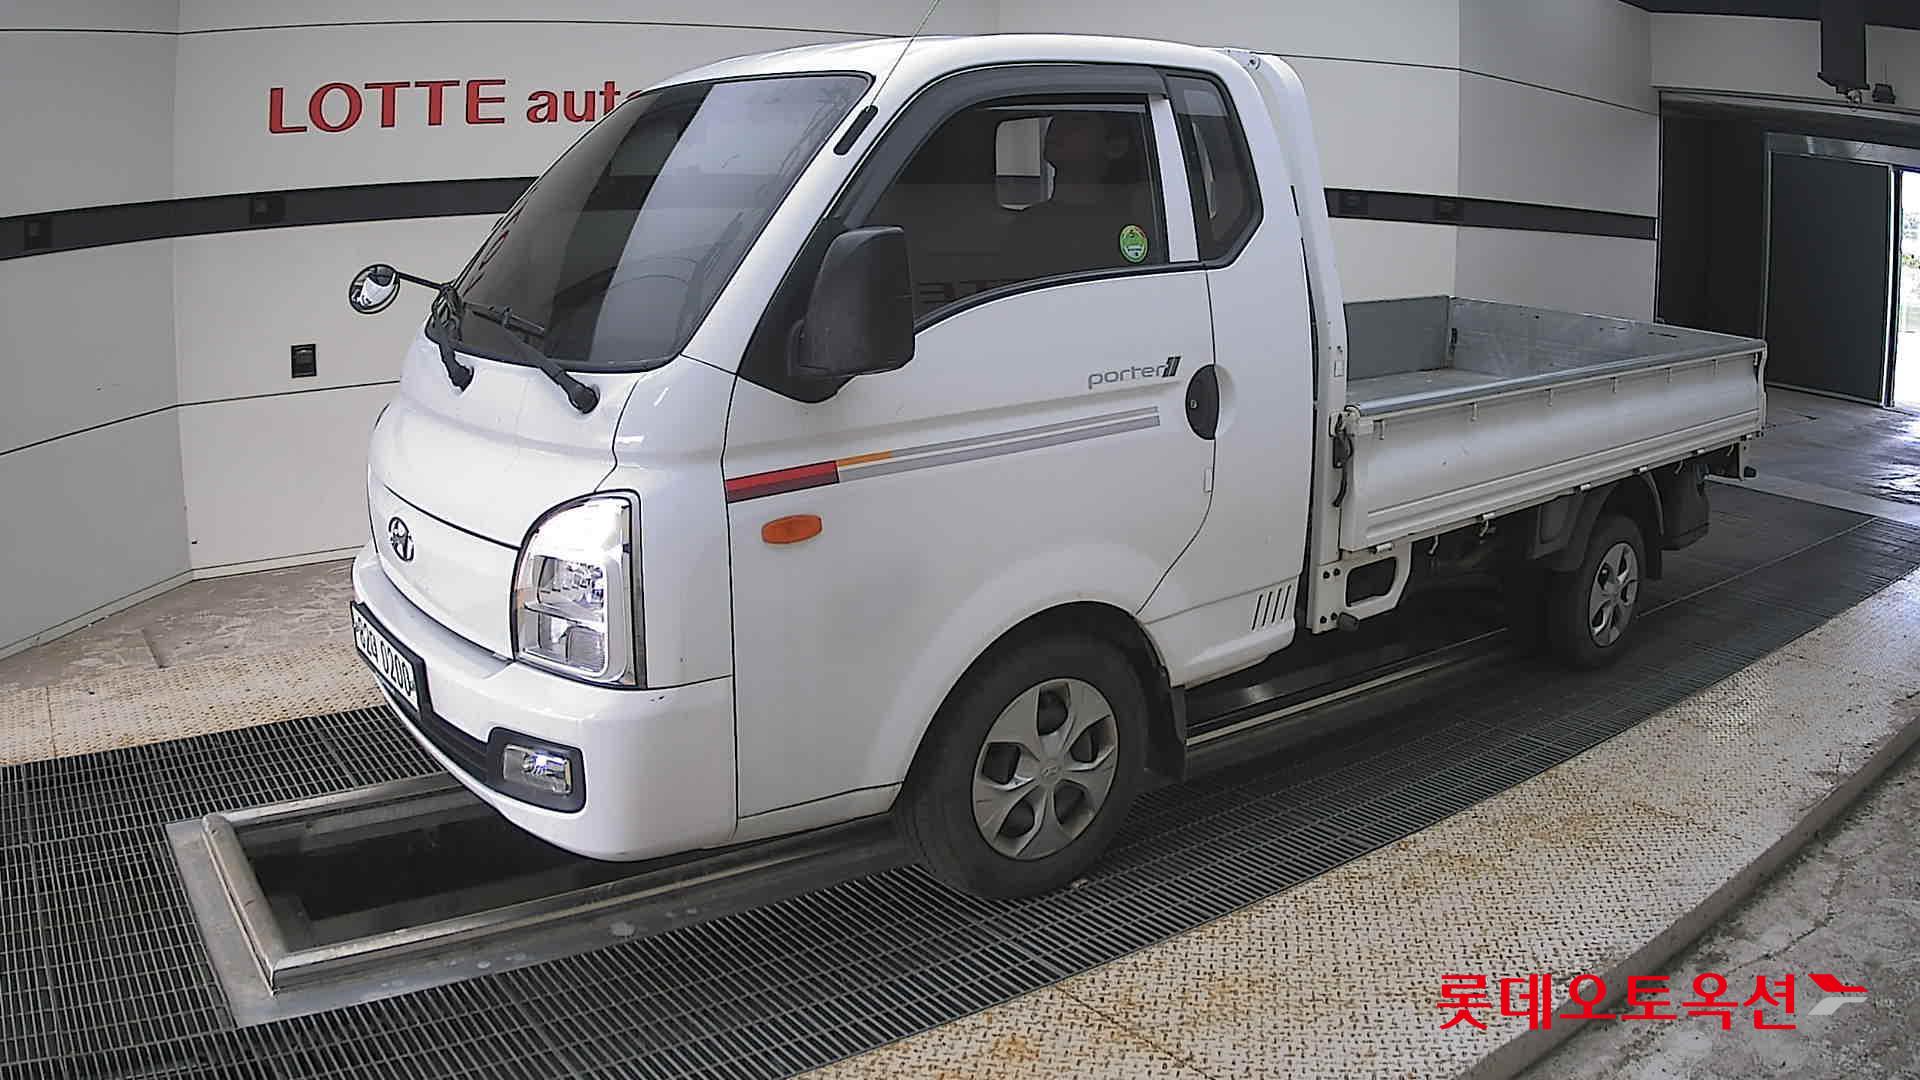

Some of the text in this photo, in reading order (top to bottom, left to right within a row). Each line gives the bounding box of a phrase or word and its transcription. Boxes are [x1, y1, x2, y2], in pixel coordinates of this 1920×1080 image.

[268, 79, 643, 135] LOTTE aut
[380, 640, 412, 697] 0200
